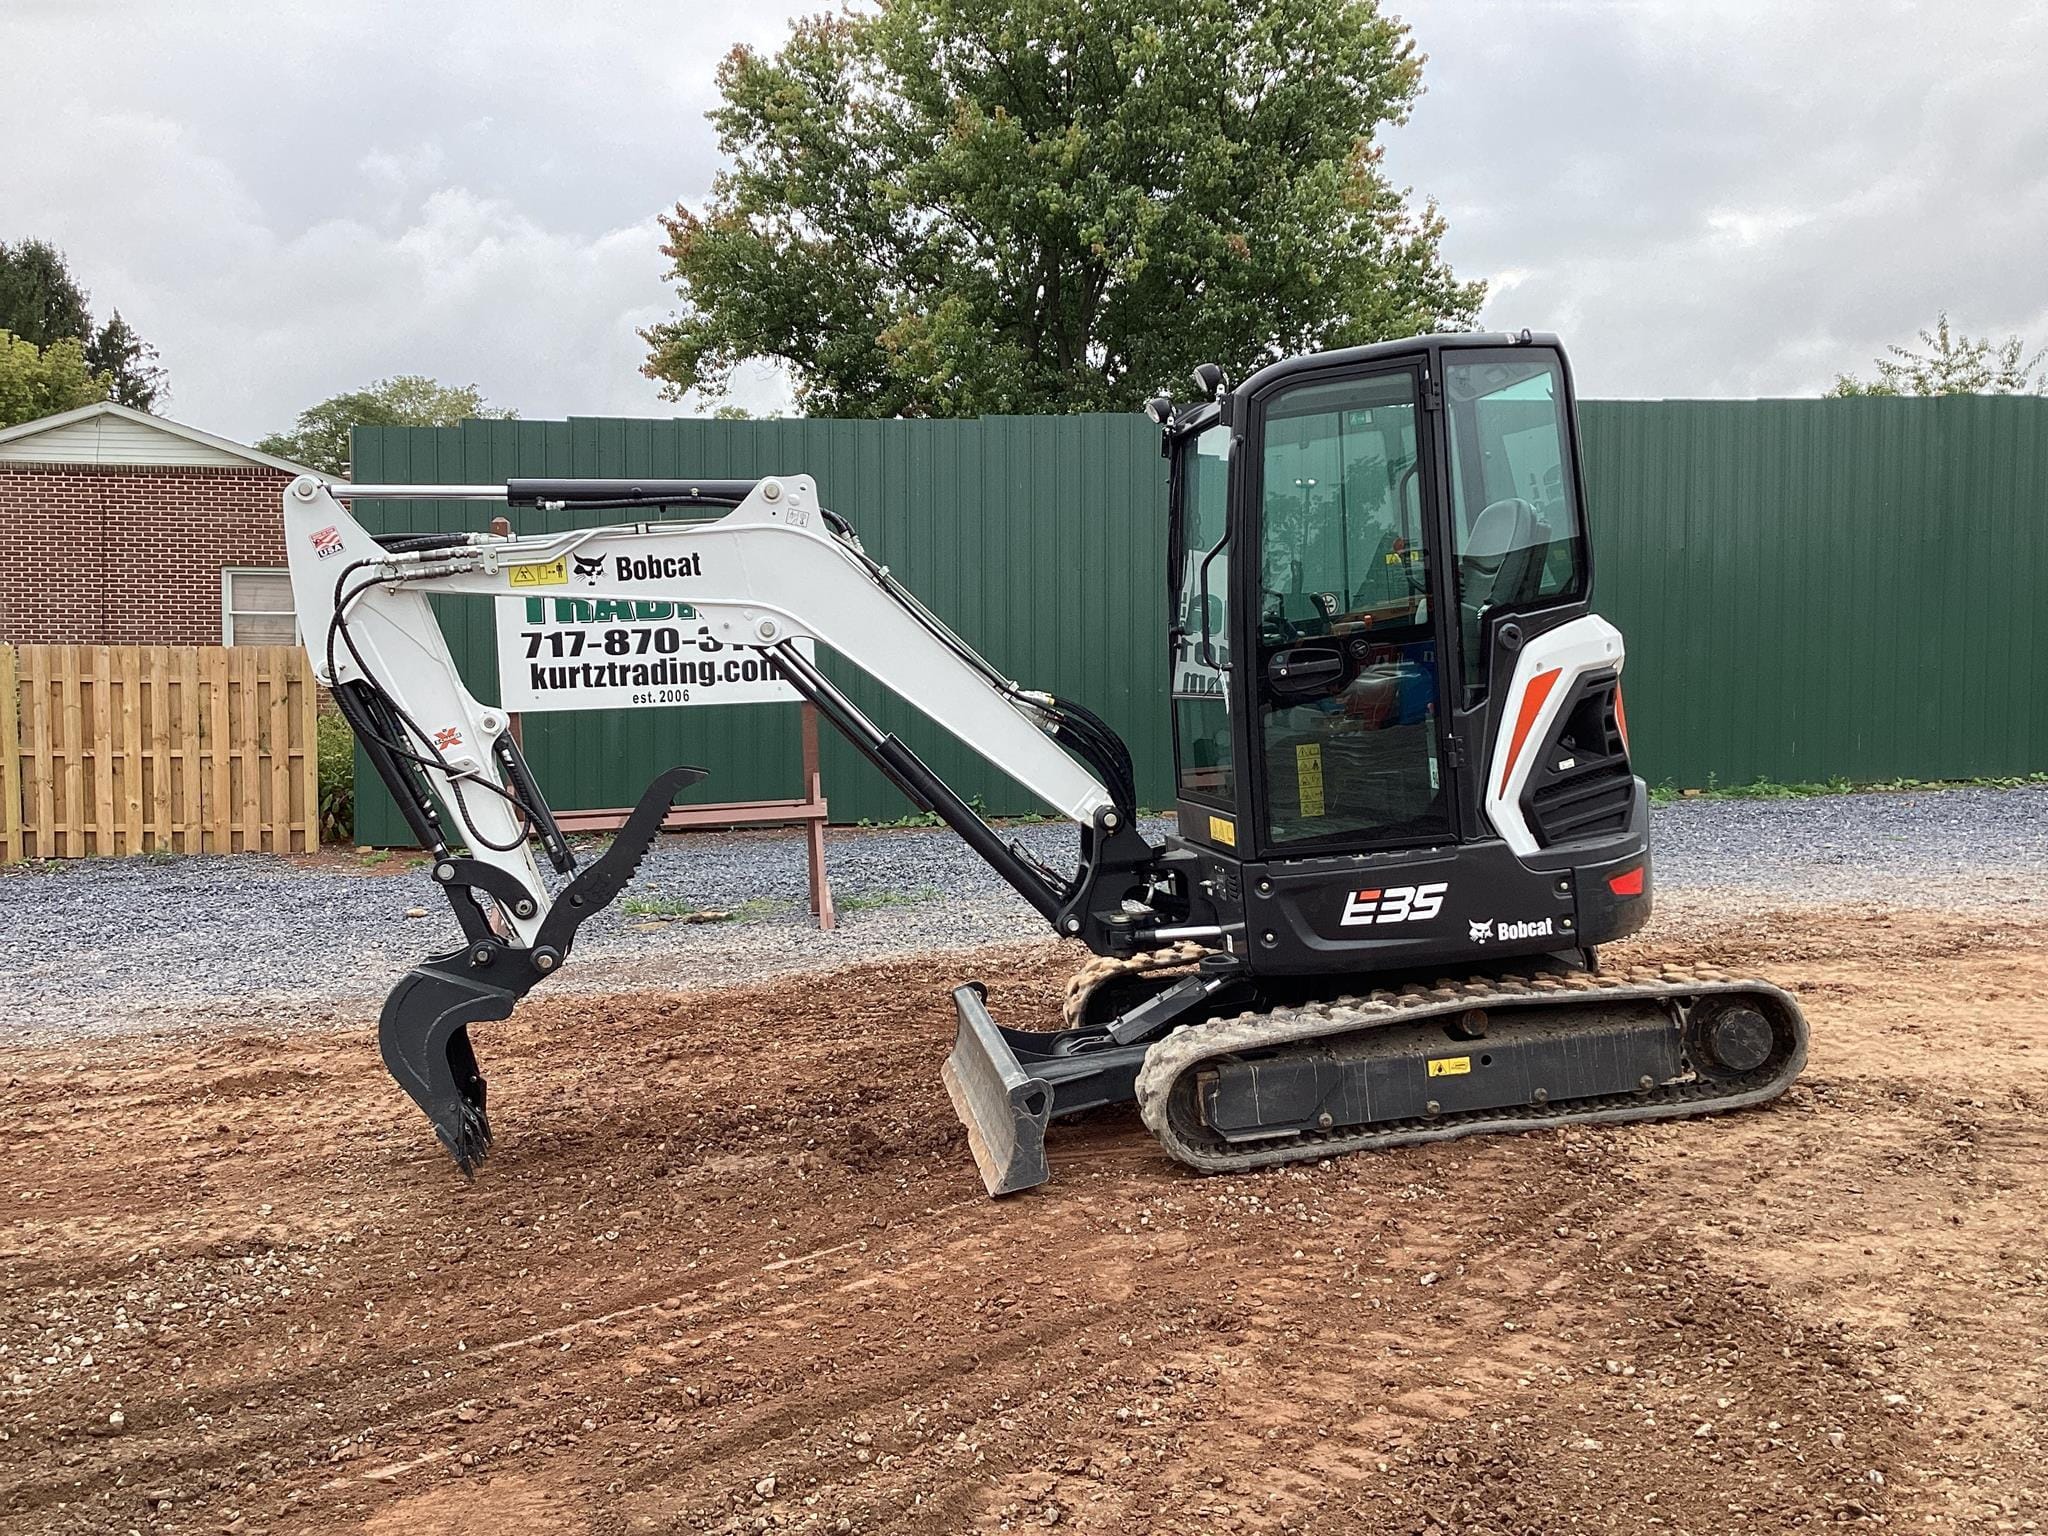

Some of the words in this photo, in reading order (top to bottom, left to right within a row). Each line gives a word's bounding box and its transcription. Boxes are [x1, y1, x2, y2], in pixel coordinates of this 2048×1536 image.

[615, 552, 702, 582] Bobcat
[530, 657, 788, 690] kurtztrading.com
[632, 691, 656, 704] est.
[659, 688, 690, 703] 2006
[1339, 882, 1449, 927] E35
[1497, 917, 1553, 941] Bobcat
